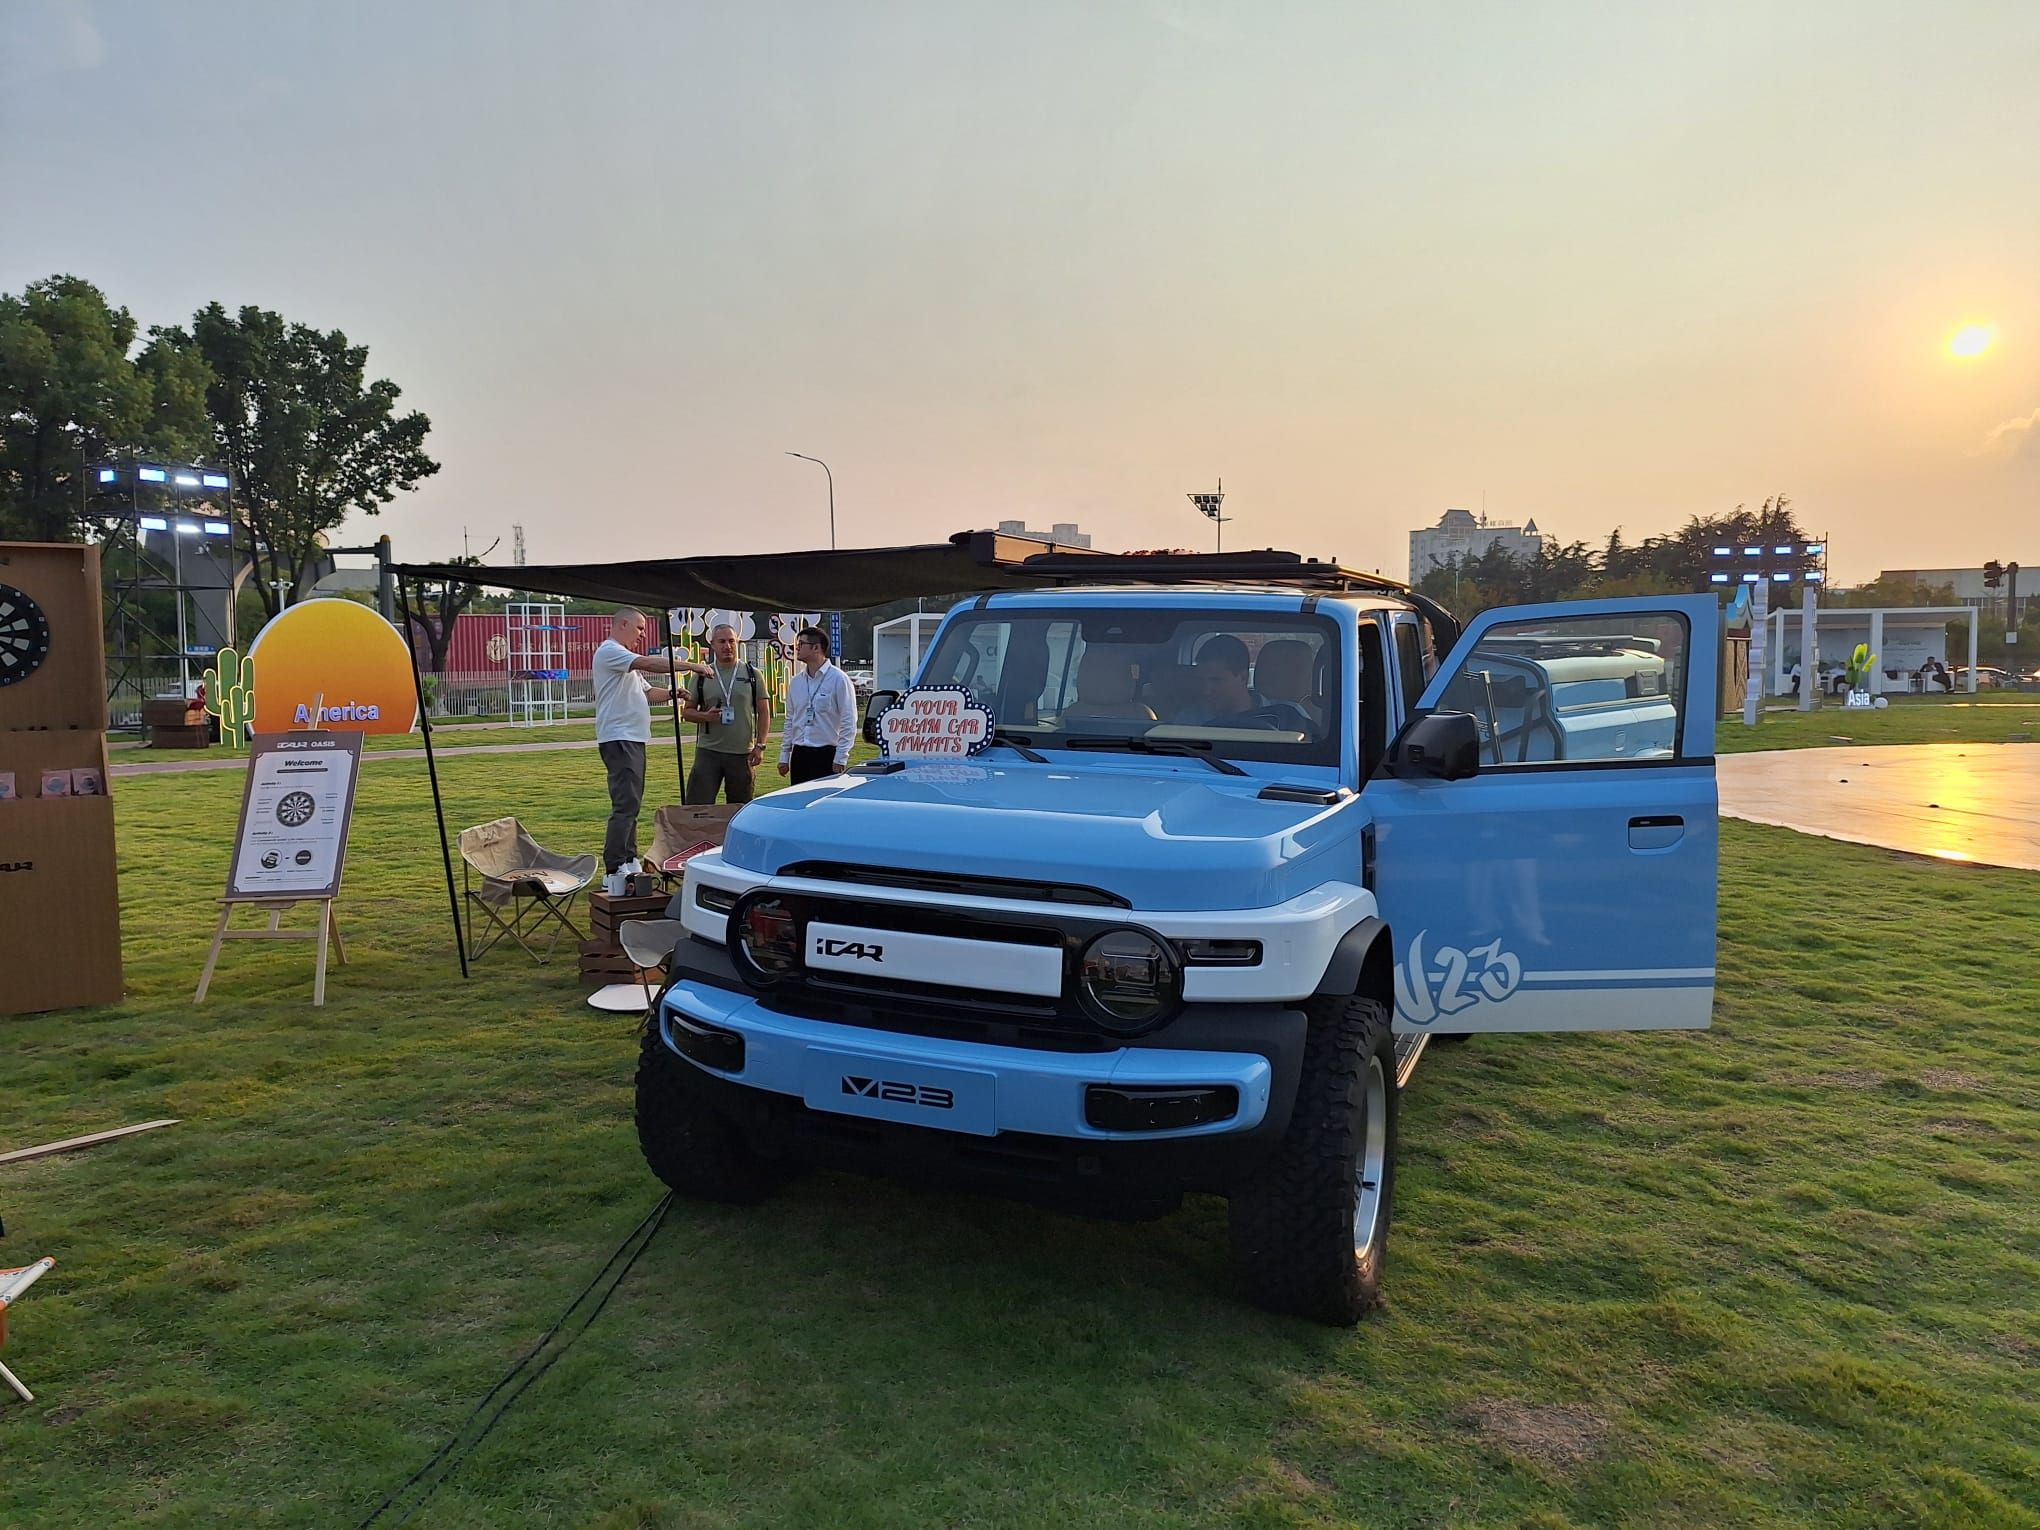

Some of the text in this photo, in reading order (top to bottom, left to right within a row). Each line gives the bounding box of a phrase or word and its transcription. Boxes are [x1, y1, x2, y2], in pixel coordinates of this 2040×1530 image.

[1848, 689, 1870, 706] Asia
[911, 700, 958, 716] YOUR
[888, 718, 980, 736] DREAM CAR
[311, 740, 336, 748] OASIS
[895, 736, 962, 754] AWAITS
[284, 759, 324, 767] Welcome
[816, 937, 884, 963] iCAR
[1393, 928, 1521, 1026] V23
[841, 1074, 955, 1110] V23
